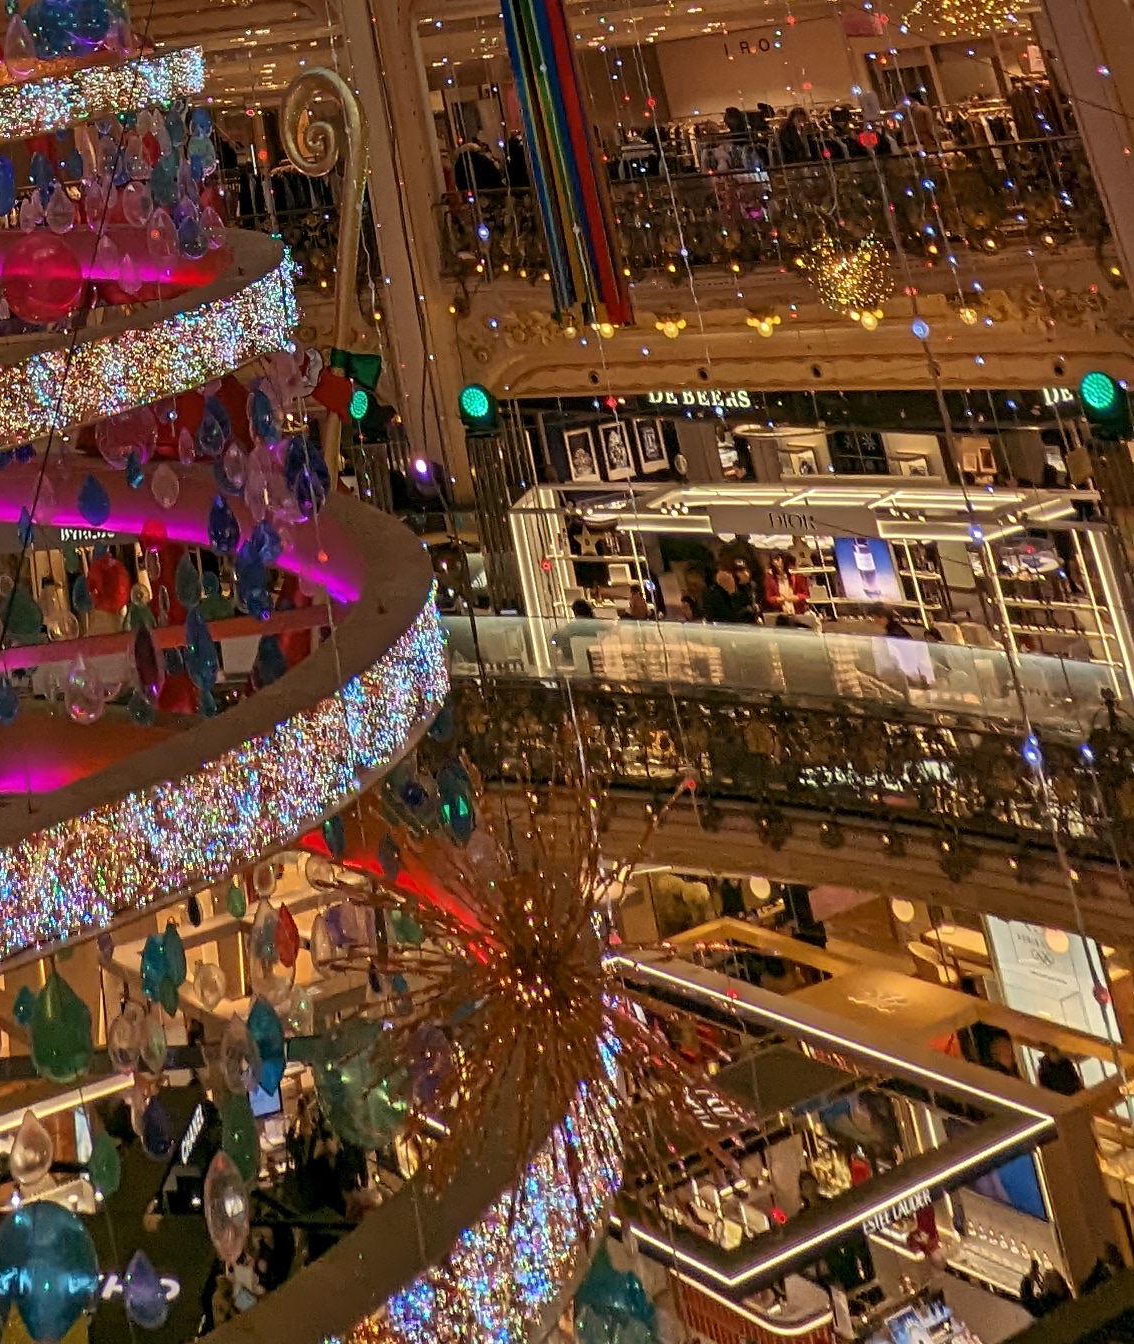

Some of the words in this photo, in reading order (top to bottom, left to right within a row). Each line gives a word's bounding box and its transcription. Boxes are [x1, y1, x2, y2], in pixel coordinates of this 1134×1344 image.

[723, 38, 770, 57] IRO
[681, 389, 752, 409] BEERS
[768, 512, 817, 530] DIOR
